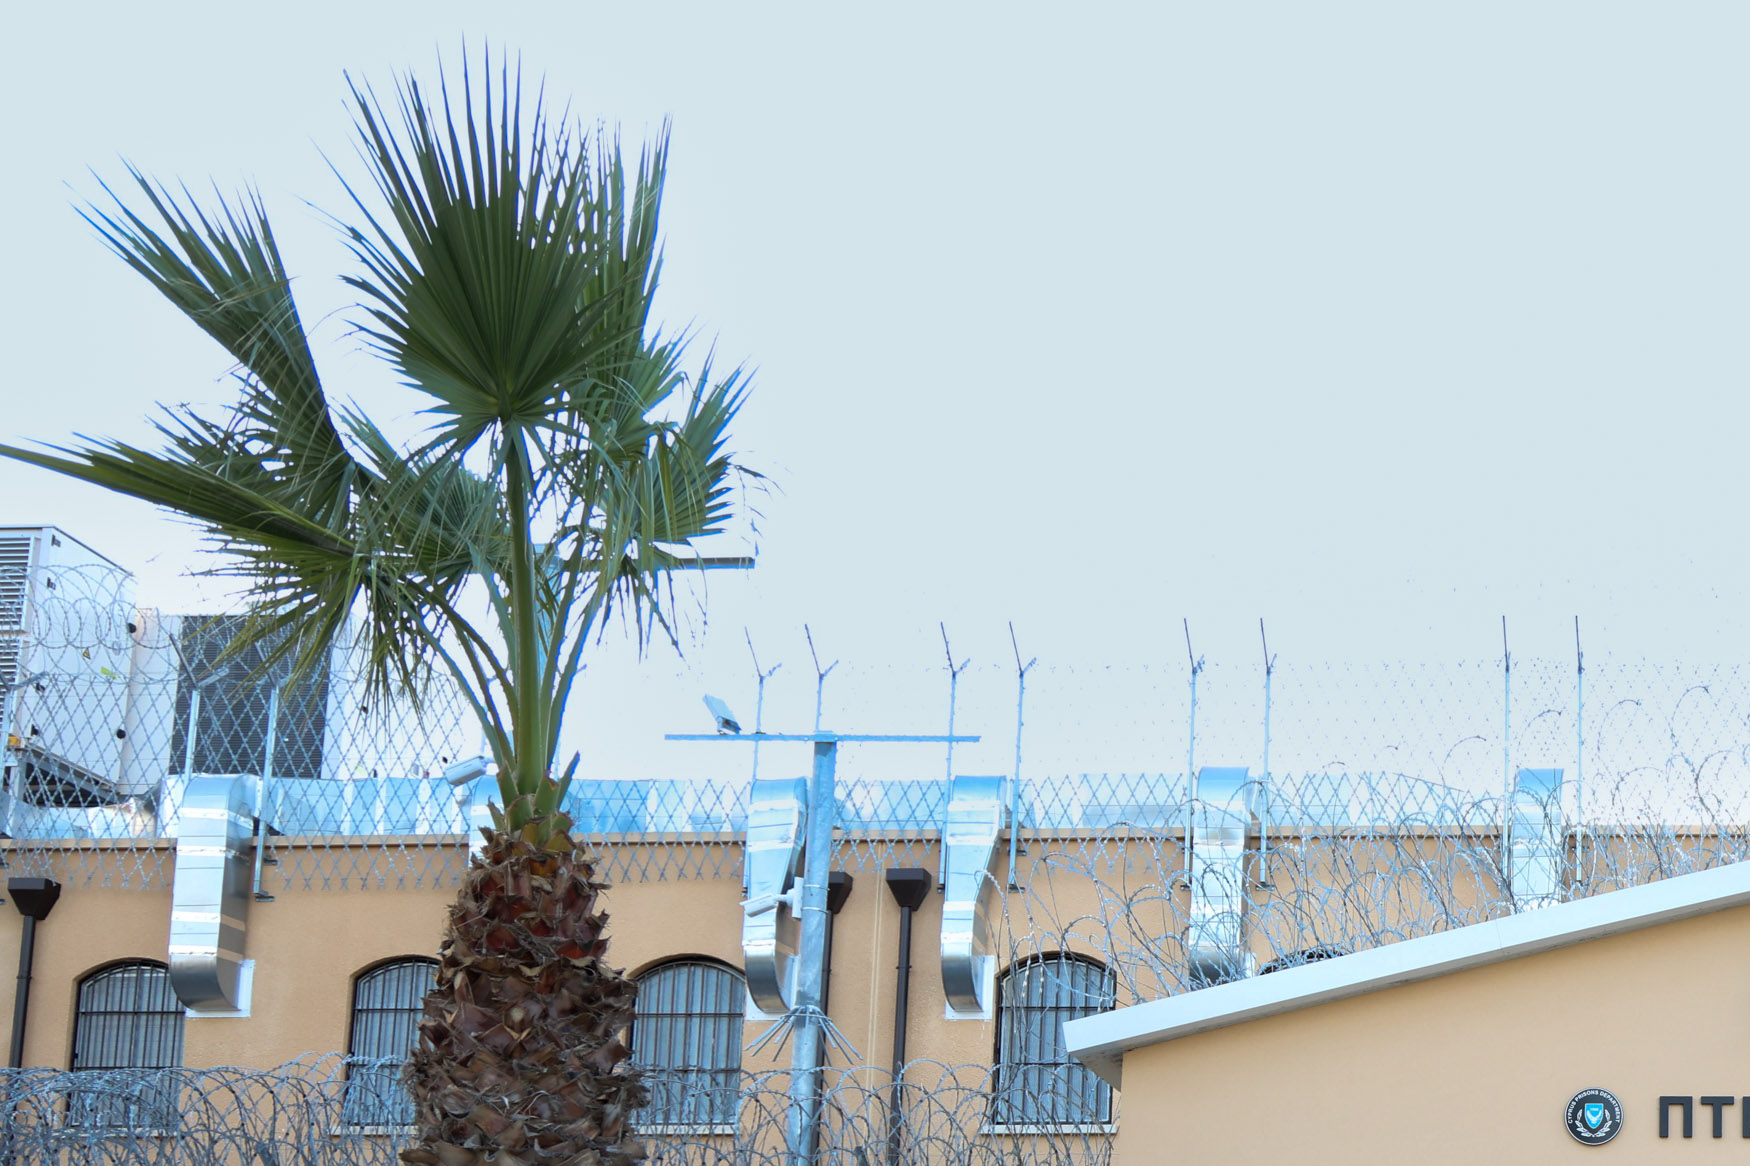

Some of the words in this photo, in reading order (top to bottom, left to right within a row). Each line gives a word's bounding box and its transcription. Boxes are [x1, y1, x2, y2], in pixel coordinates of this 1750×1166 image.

[1567, 1101, 1577, 1124] CYPRUS
[1574, 1090, 1599, 1102] PRISONS
[1599, 1091, 1621, 1123] DEPARTMENT
